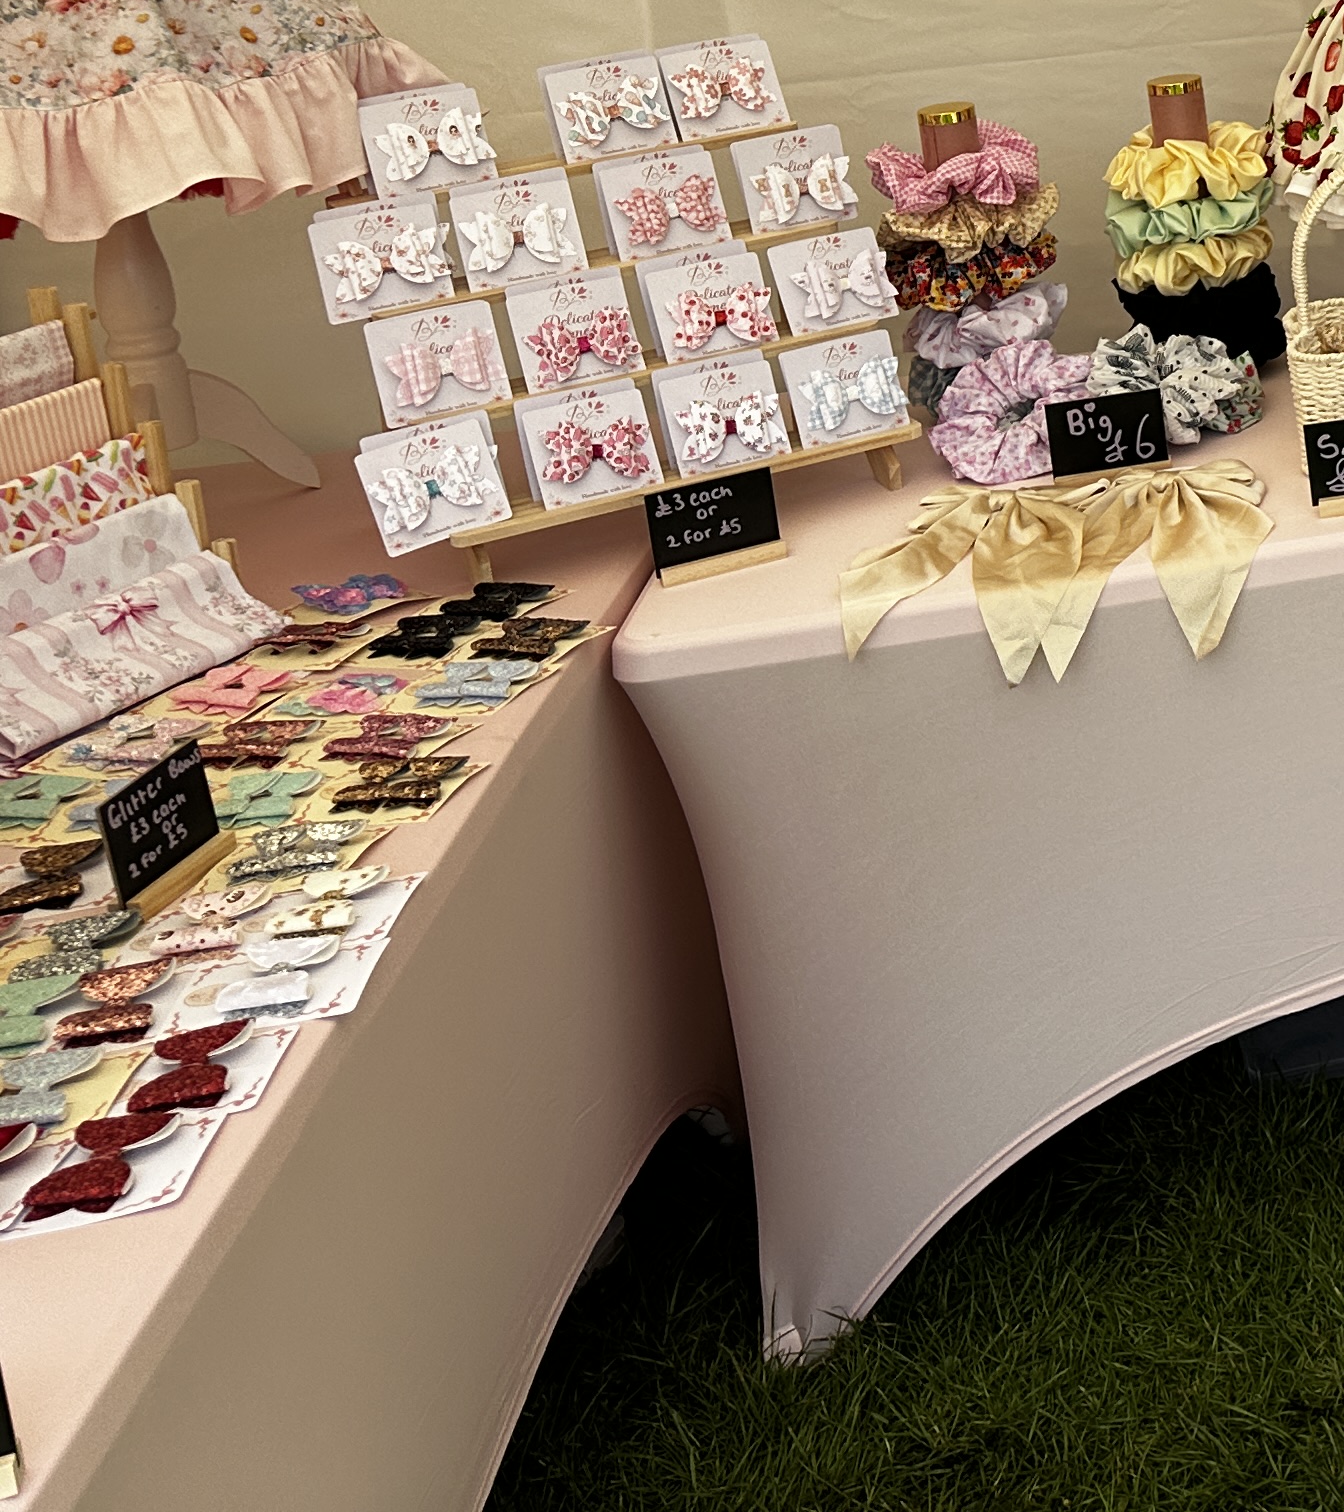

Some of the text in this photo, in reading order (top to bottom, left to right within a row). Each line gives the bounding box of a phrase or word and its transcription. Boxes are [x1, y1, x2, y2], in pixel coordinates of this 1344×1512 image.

[1066, 402, 1112, 442] Big
[655, 486, 733, 518] £3 each
[696, 505, 718, 520] or
[666, 535, 681, 548] 2
[719, 518, 742, 537] £5
[107, 776, 163, 829] Glitter
[130, 793, 187, 844] £3 each
[162, 813, 178, 834] or
[128, 863, 141, 879] 2
[168, 823, 188, 849] £5
